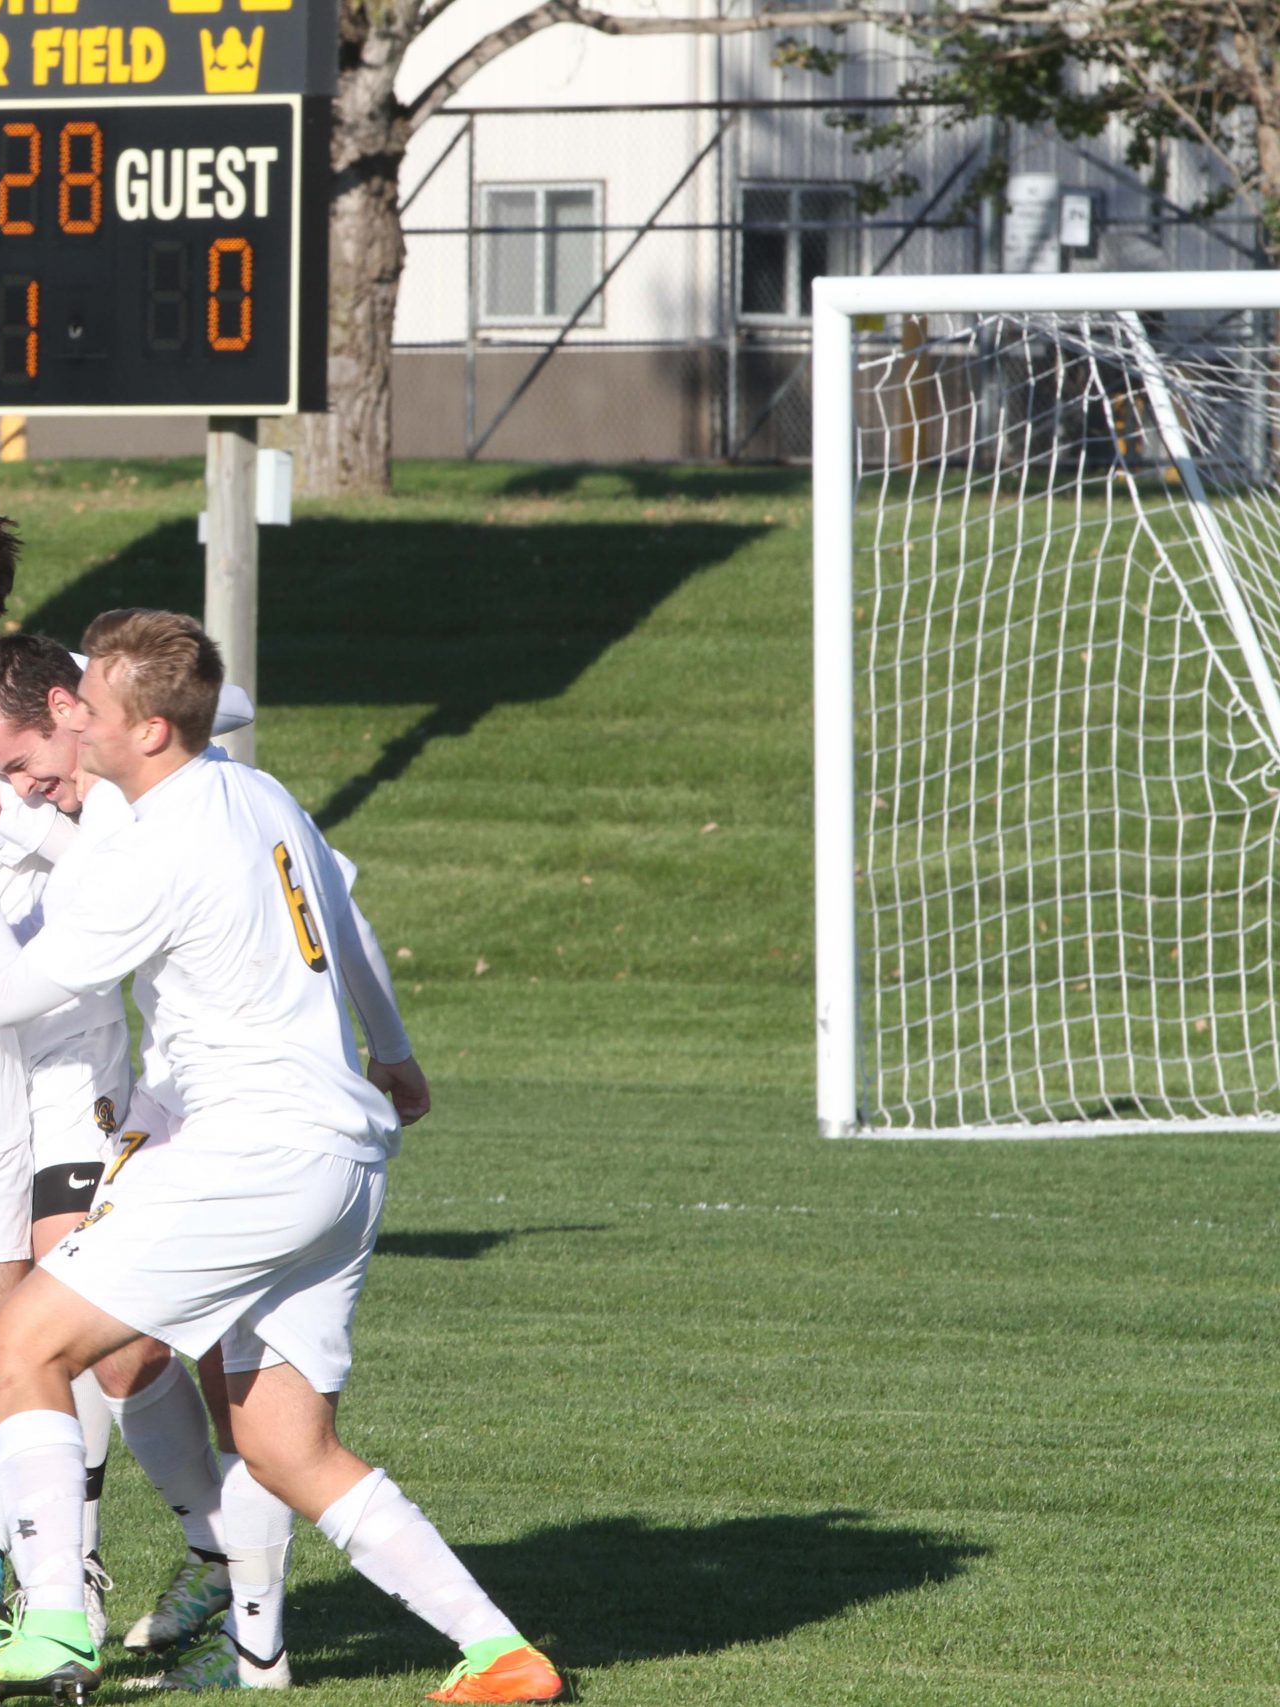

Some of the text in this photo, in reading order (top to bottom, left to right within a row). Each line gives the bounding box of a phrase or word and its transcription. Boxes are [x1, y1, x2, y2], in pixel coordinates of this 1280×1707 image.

[32, 26, 166, 86] FIELD
[115, 146, 278, 221] GUEST
[26, 280, 39, 378] 1
[207, 238, 253, 351] 0
[273, 841, 328, 973] 6
[104, 1131, 151, 1185] 7
